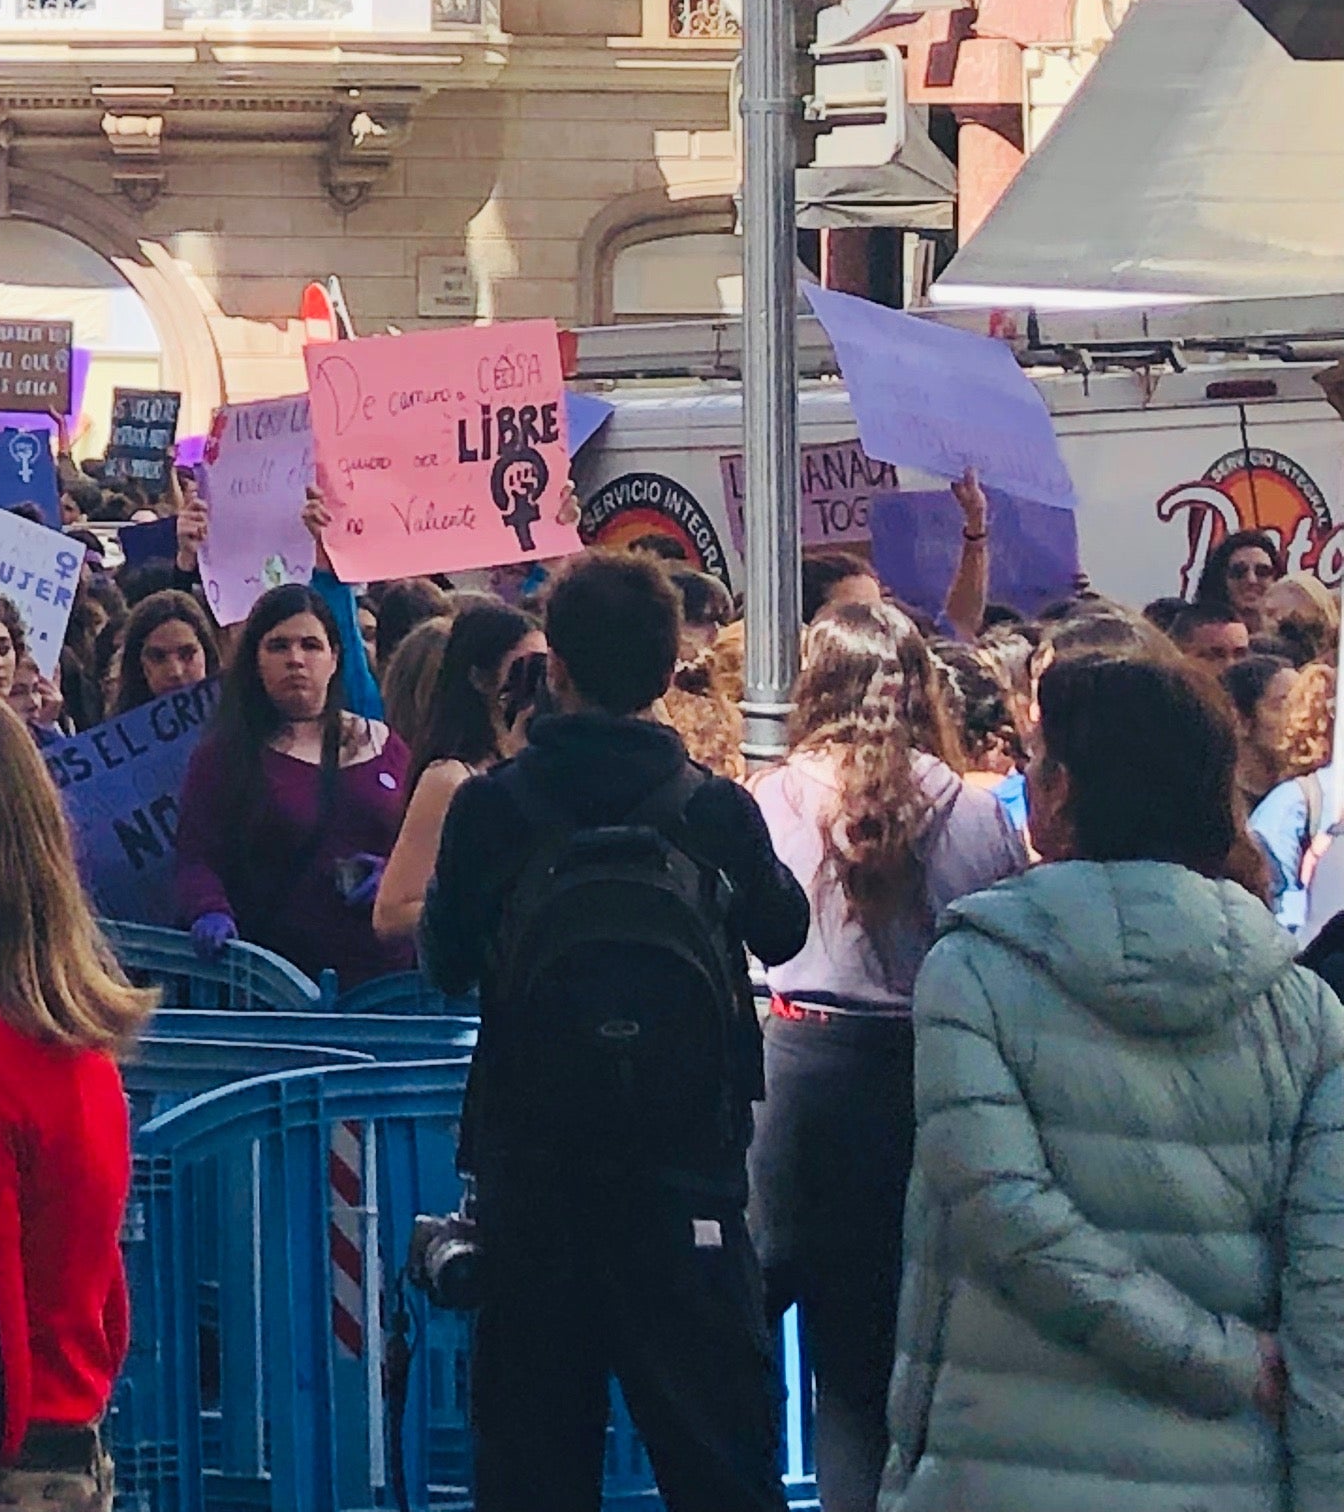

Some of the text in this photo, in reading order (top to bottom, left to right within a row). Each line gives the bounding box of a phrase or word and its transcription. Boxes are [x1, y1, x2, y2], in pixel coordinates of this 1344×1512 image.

[316, 355, 378, 436] De
[388, 387, 450, 416] camino
[477, 352, 543, 393] CASA
[338, 457, 392, 489] quiero
[457, 401, 560, 464] LIBRE
[801, 449, 898, 493] ANADA
[582, 480, 723, 578] SERVICIO INTEGRA
[813, 496, 870, 536] TOG
[90, 721, 149, 770] EL
